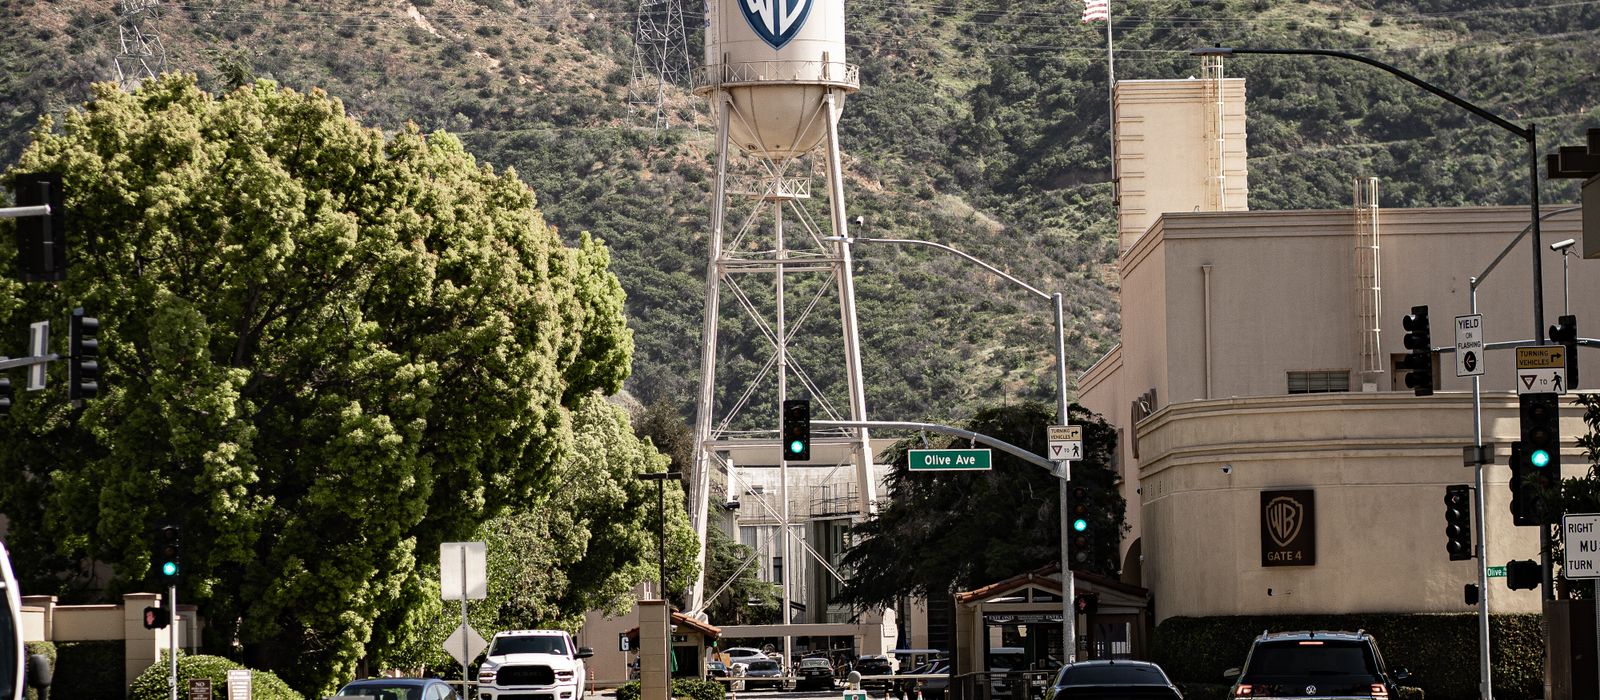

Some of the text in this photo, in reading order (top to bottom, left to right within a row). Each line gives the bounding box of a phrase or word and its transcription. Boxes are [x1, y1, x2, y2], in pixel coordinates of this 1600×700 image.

[1458, 319, 1479, 329] YIELD
[1458, 341, 1481, 349] FLASHING
[924, 454, 976, 466] Olive Ave
[1269, 502, 1297, 540] WB
[1568, 523, 1594, 533] RIGHT
[1580, 540, 1600, 552] MU
[1267, 550, 1302, 561] GATE 4
[1568, 560, 1593, 570] TURN
[1487, 567, 1502, 577] Olive
